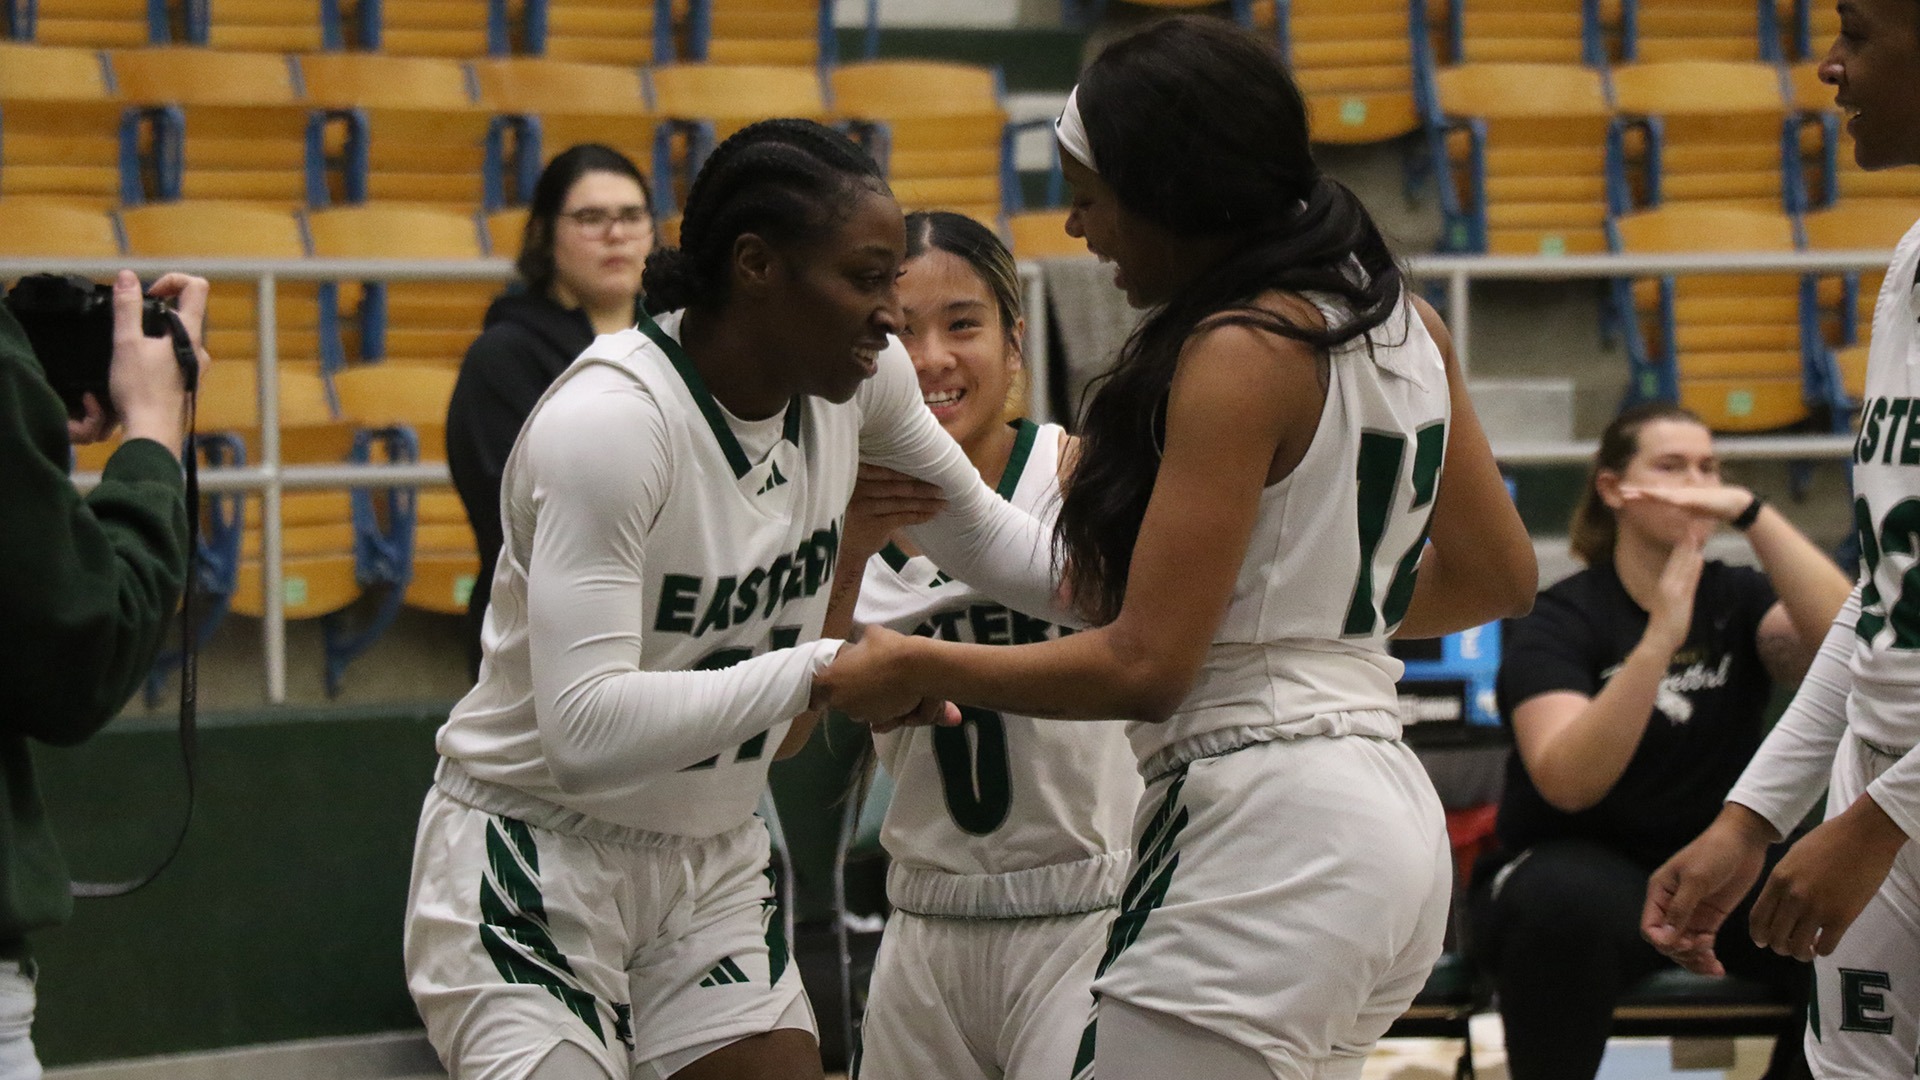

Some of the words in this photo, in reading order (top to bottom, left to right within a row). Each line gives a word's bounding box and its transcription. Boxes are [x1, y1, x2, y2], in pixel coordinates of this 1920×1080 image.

[1338, 418, 1446, 639] 12
[931, 702, 1014, 838] 0
[1838, 967, 1894, 1035] E
